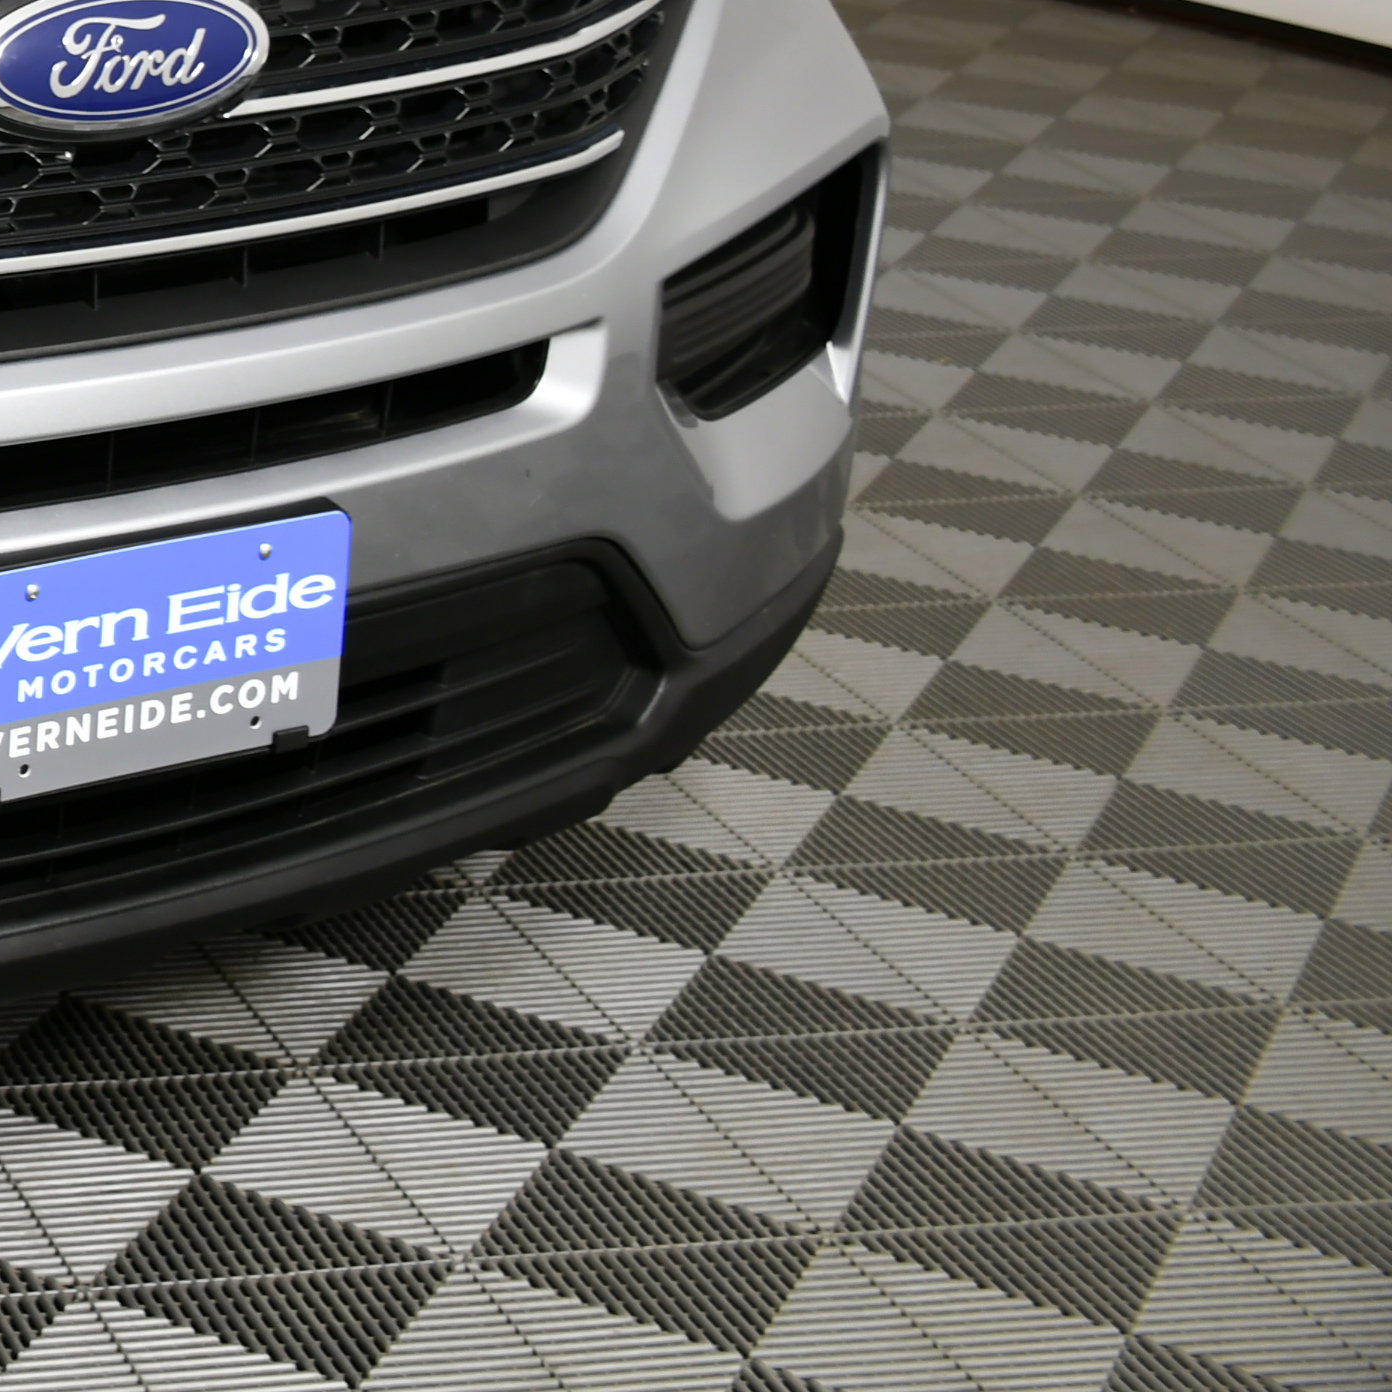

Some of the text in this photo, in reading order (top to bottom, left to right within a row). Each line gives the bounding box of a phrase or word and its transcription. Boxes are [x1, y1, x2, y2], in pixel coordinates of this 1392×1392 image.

[49, 12, 207, 99] Ford
[165, 571, 337, 635] Eide
[16, 626, 288, 703] MOTORCARS
